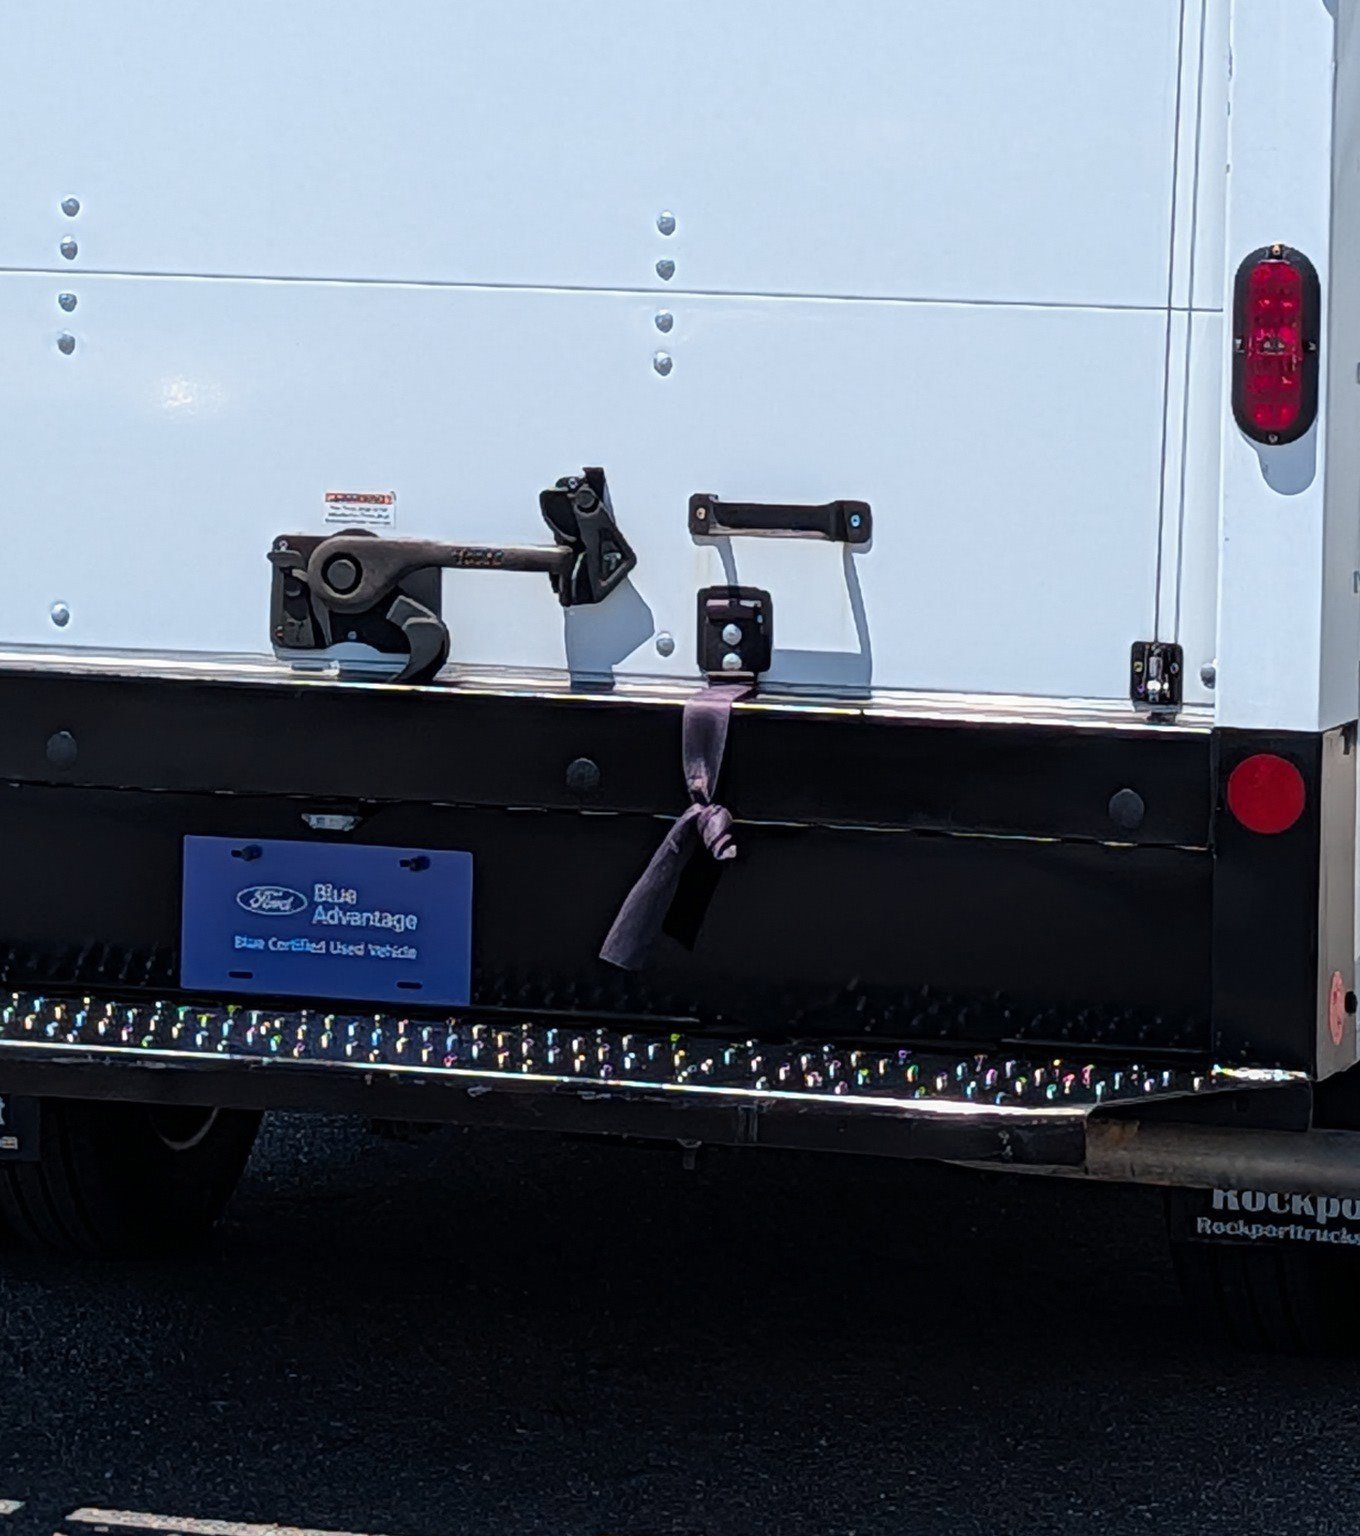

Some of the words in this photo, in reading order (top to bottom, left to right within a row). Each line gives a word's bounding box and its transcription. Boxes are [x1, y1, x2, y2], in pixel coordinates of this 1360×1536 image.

[249, 889, 295, 911] Ford
[314, 883, 357, 904] Blue
[313, 905, 417, 932] Advantage
[234, 935, 265, 949] Blue
[269, 937, 326, 953] Certified
[330, 941, 365, 956] Used
[368, 944, 417, 959] Vehicle
